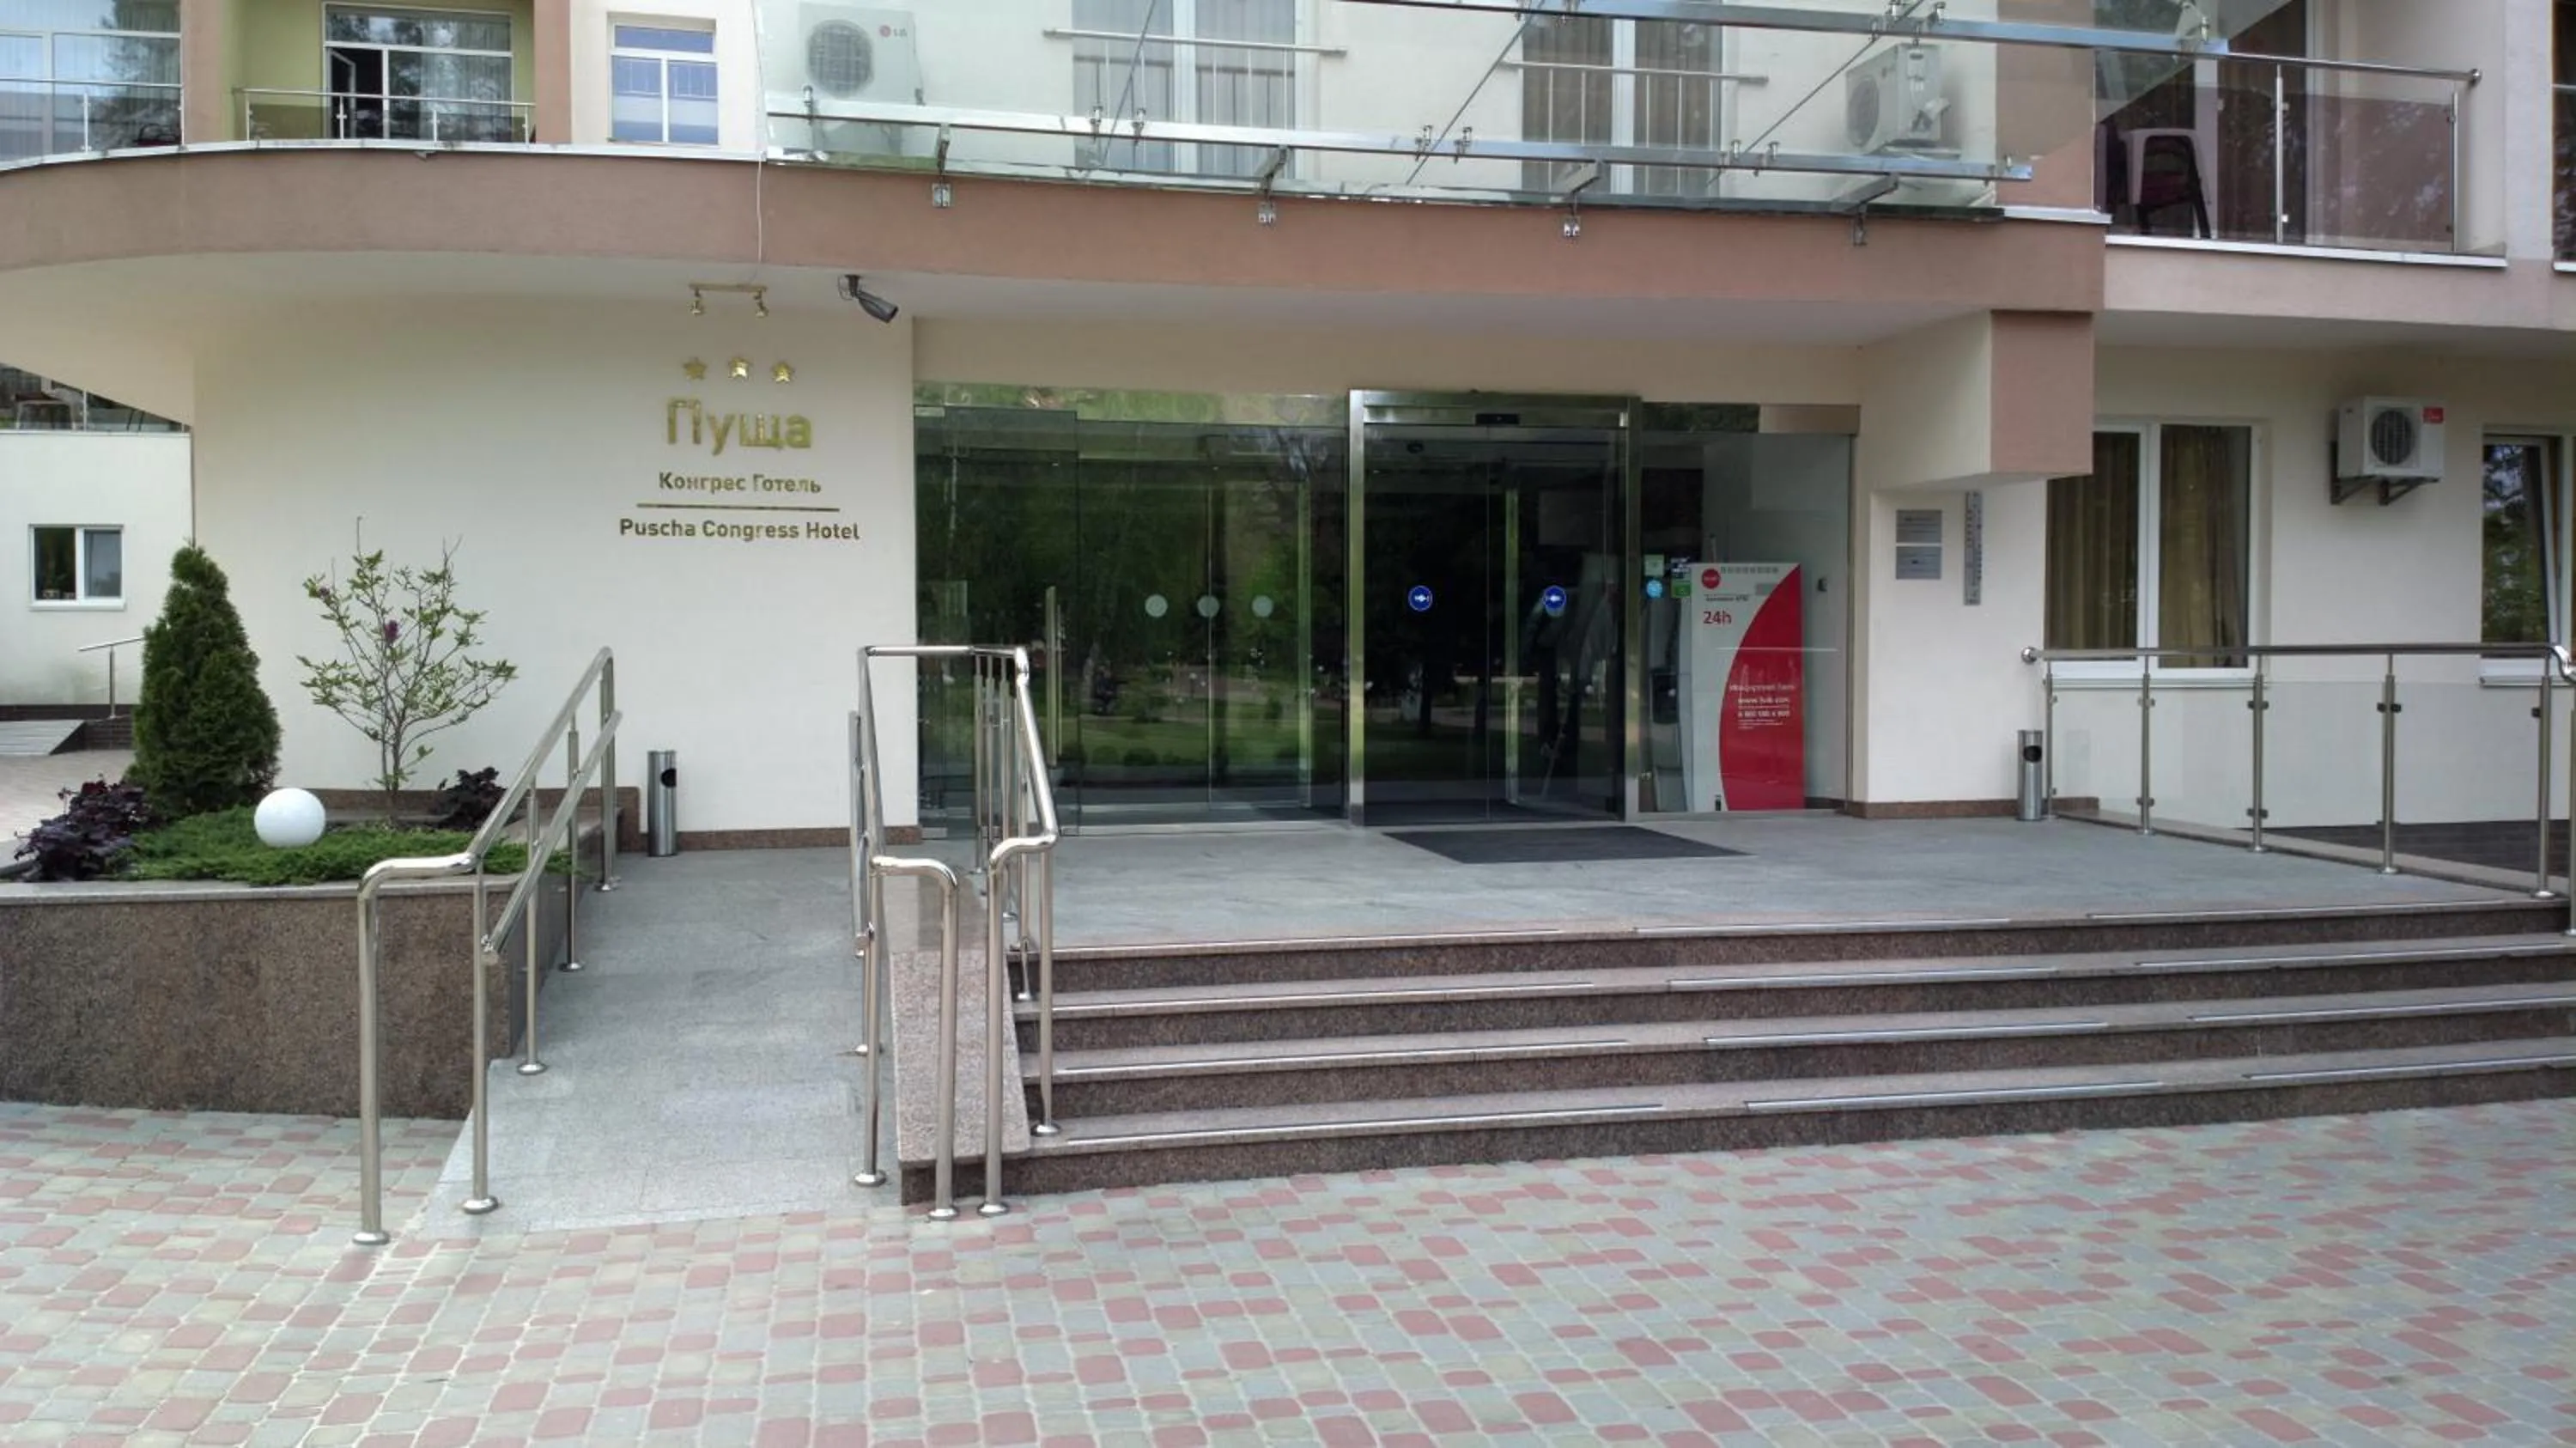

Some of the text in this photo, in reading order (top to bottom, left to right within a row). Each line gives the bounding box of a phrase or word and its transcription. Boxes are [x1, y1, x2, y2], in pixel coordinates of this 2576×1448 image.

[666, 396, 812, 456] Пуща
[659, 472, 822, 495] Конгрес Готель
[619, 518, 861, 543] Puscha Congress Hotel
[1703, 611, 1733, 625] 24h
